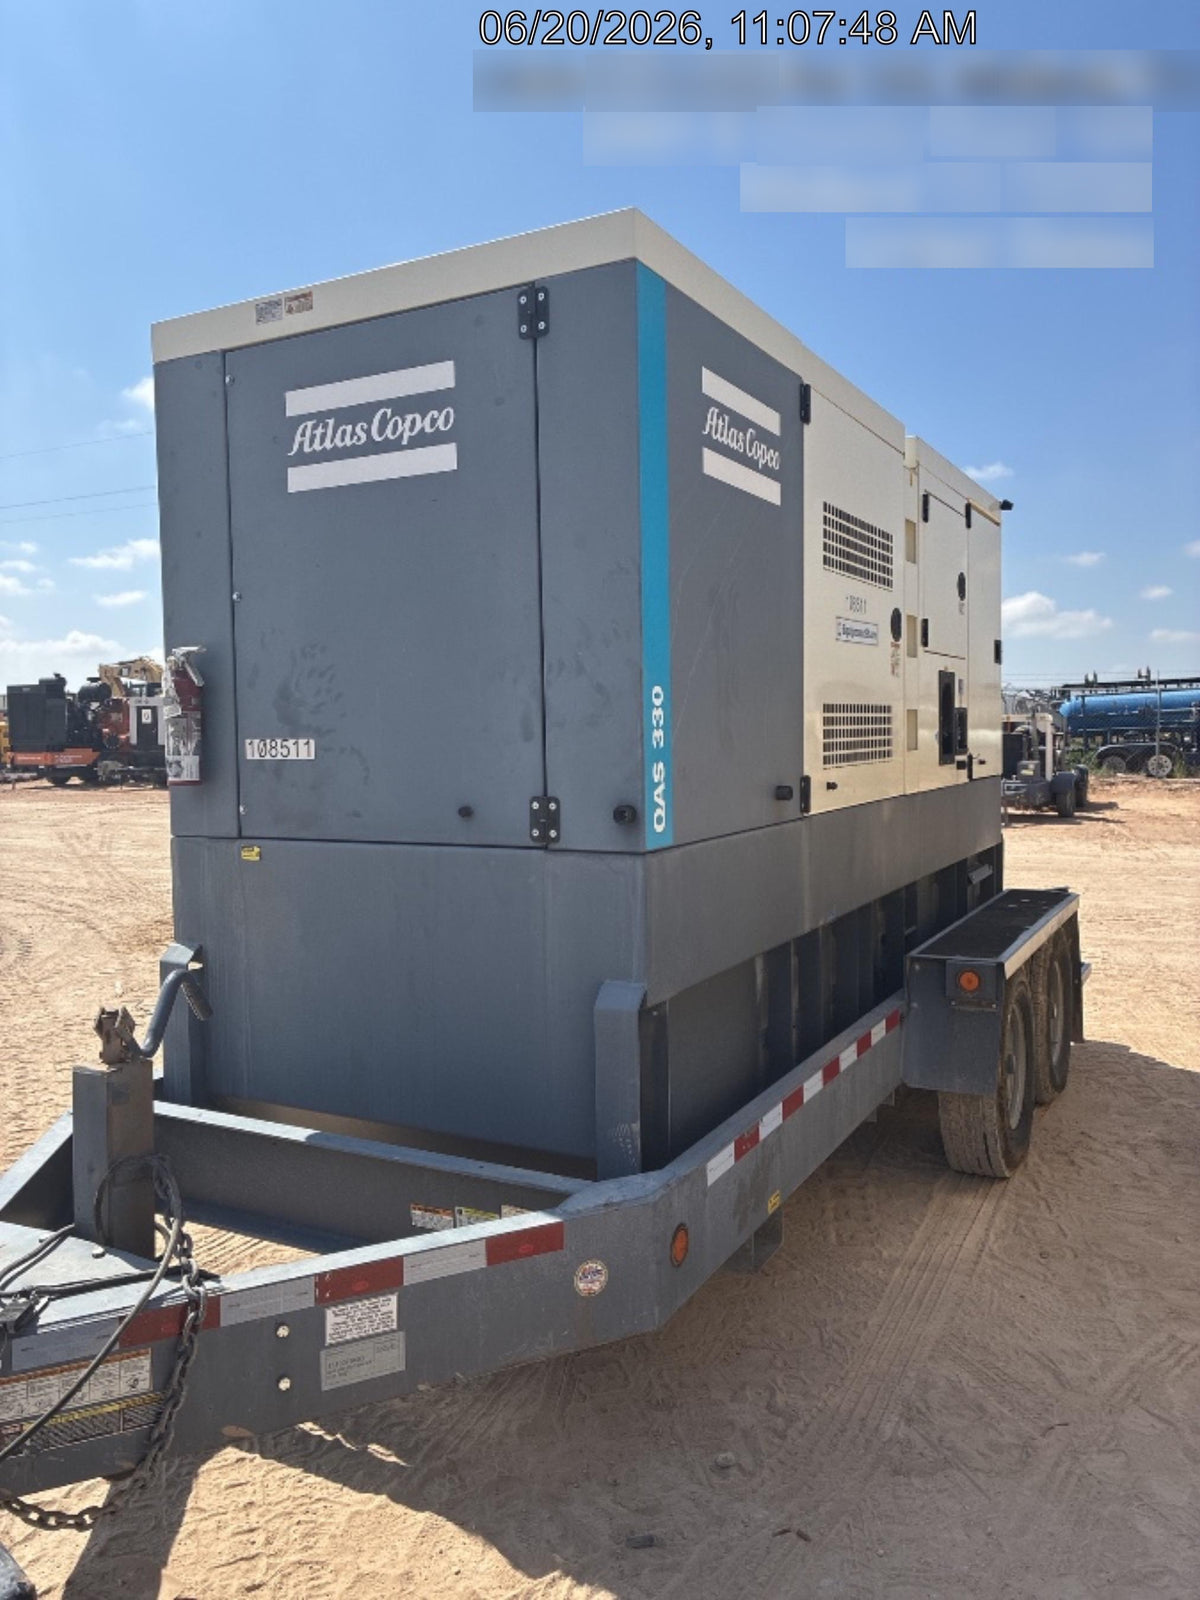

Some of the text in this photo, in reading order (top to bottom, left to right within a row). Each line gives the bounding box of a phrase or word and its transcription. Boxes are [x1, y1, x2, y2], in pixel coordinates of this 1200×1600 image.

[287, 406, 455, 456] Atlas Copco
[702, 406, 780, 471] Atlas Copco
[652, 685, 664, 749] 330
[248, 738, 312, 758] 108511
